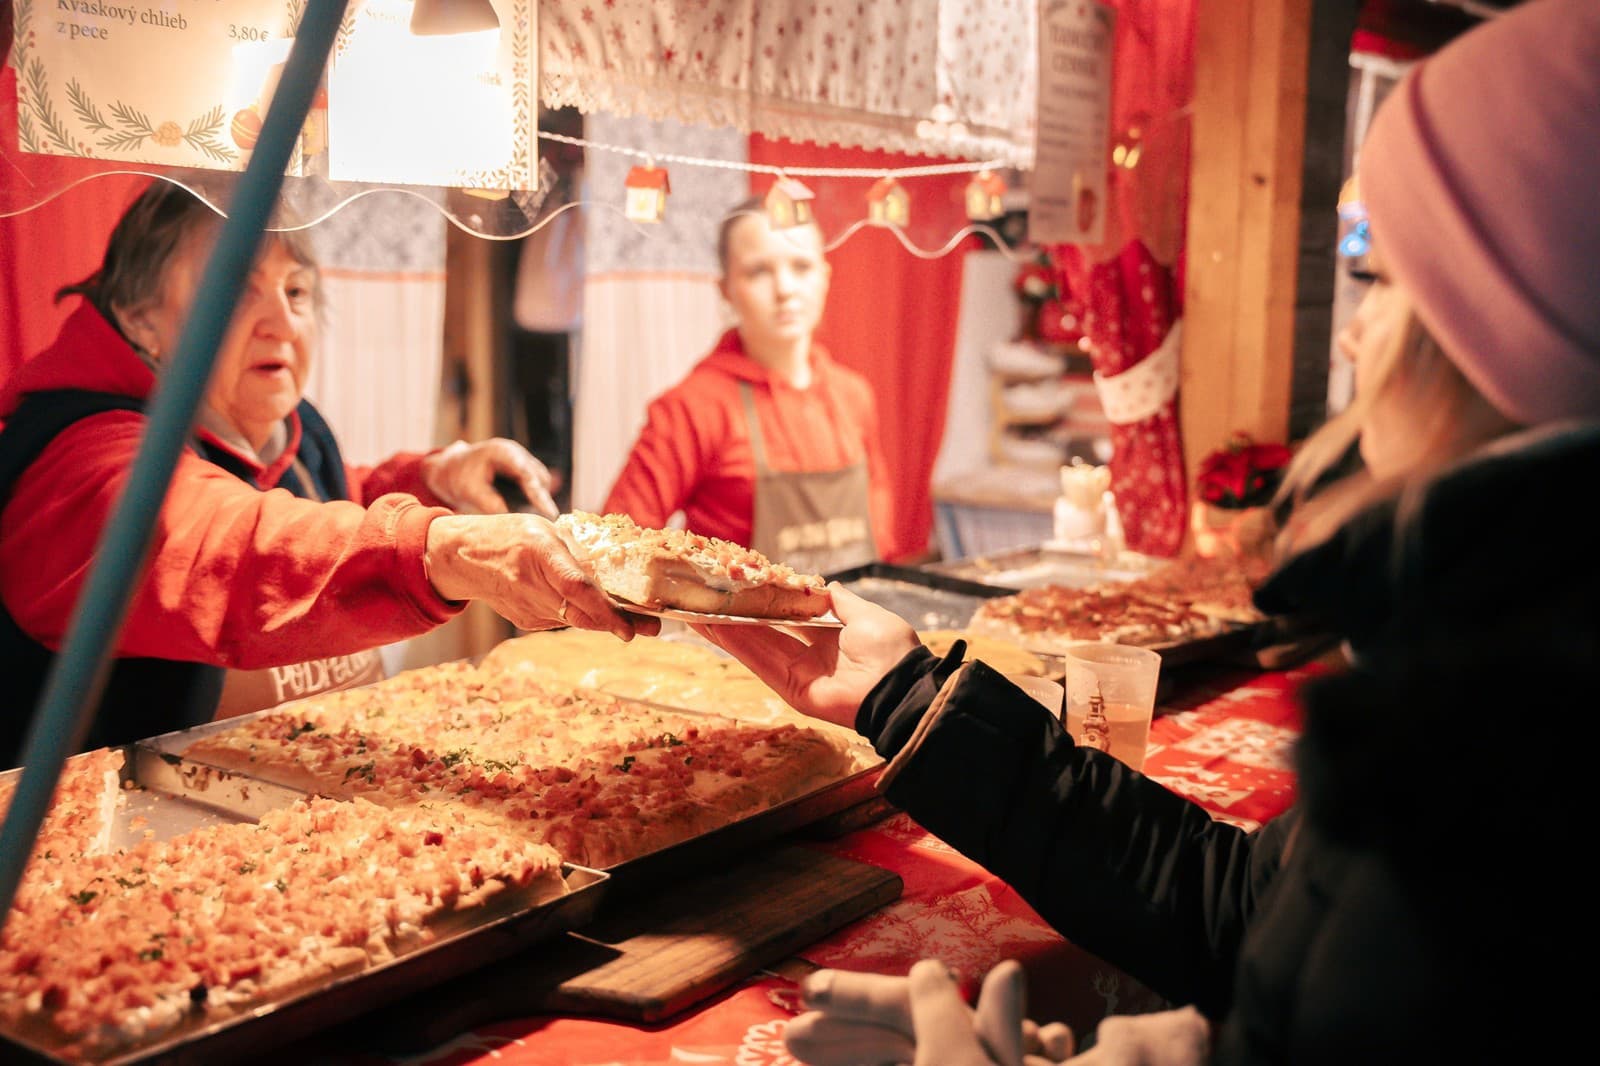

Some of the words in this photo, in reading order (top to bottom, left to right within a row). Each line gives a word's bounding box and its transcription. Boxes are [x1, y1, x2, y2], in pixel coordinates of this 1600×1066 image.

[140, 8, 188, 31] chlieb
[57, 22, 66, 34] z
[70, 23, 108, 40] pece
